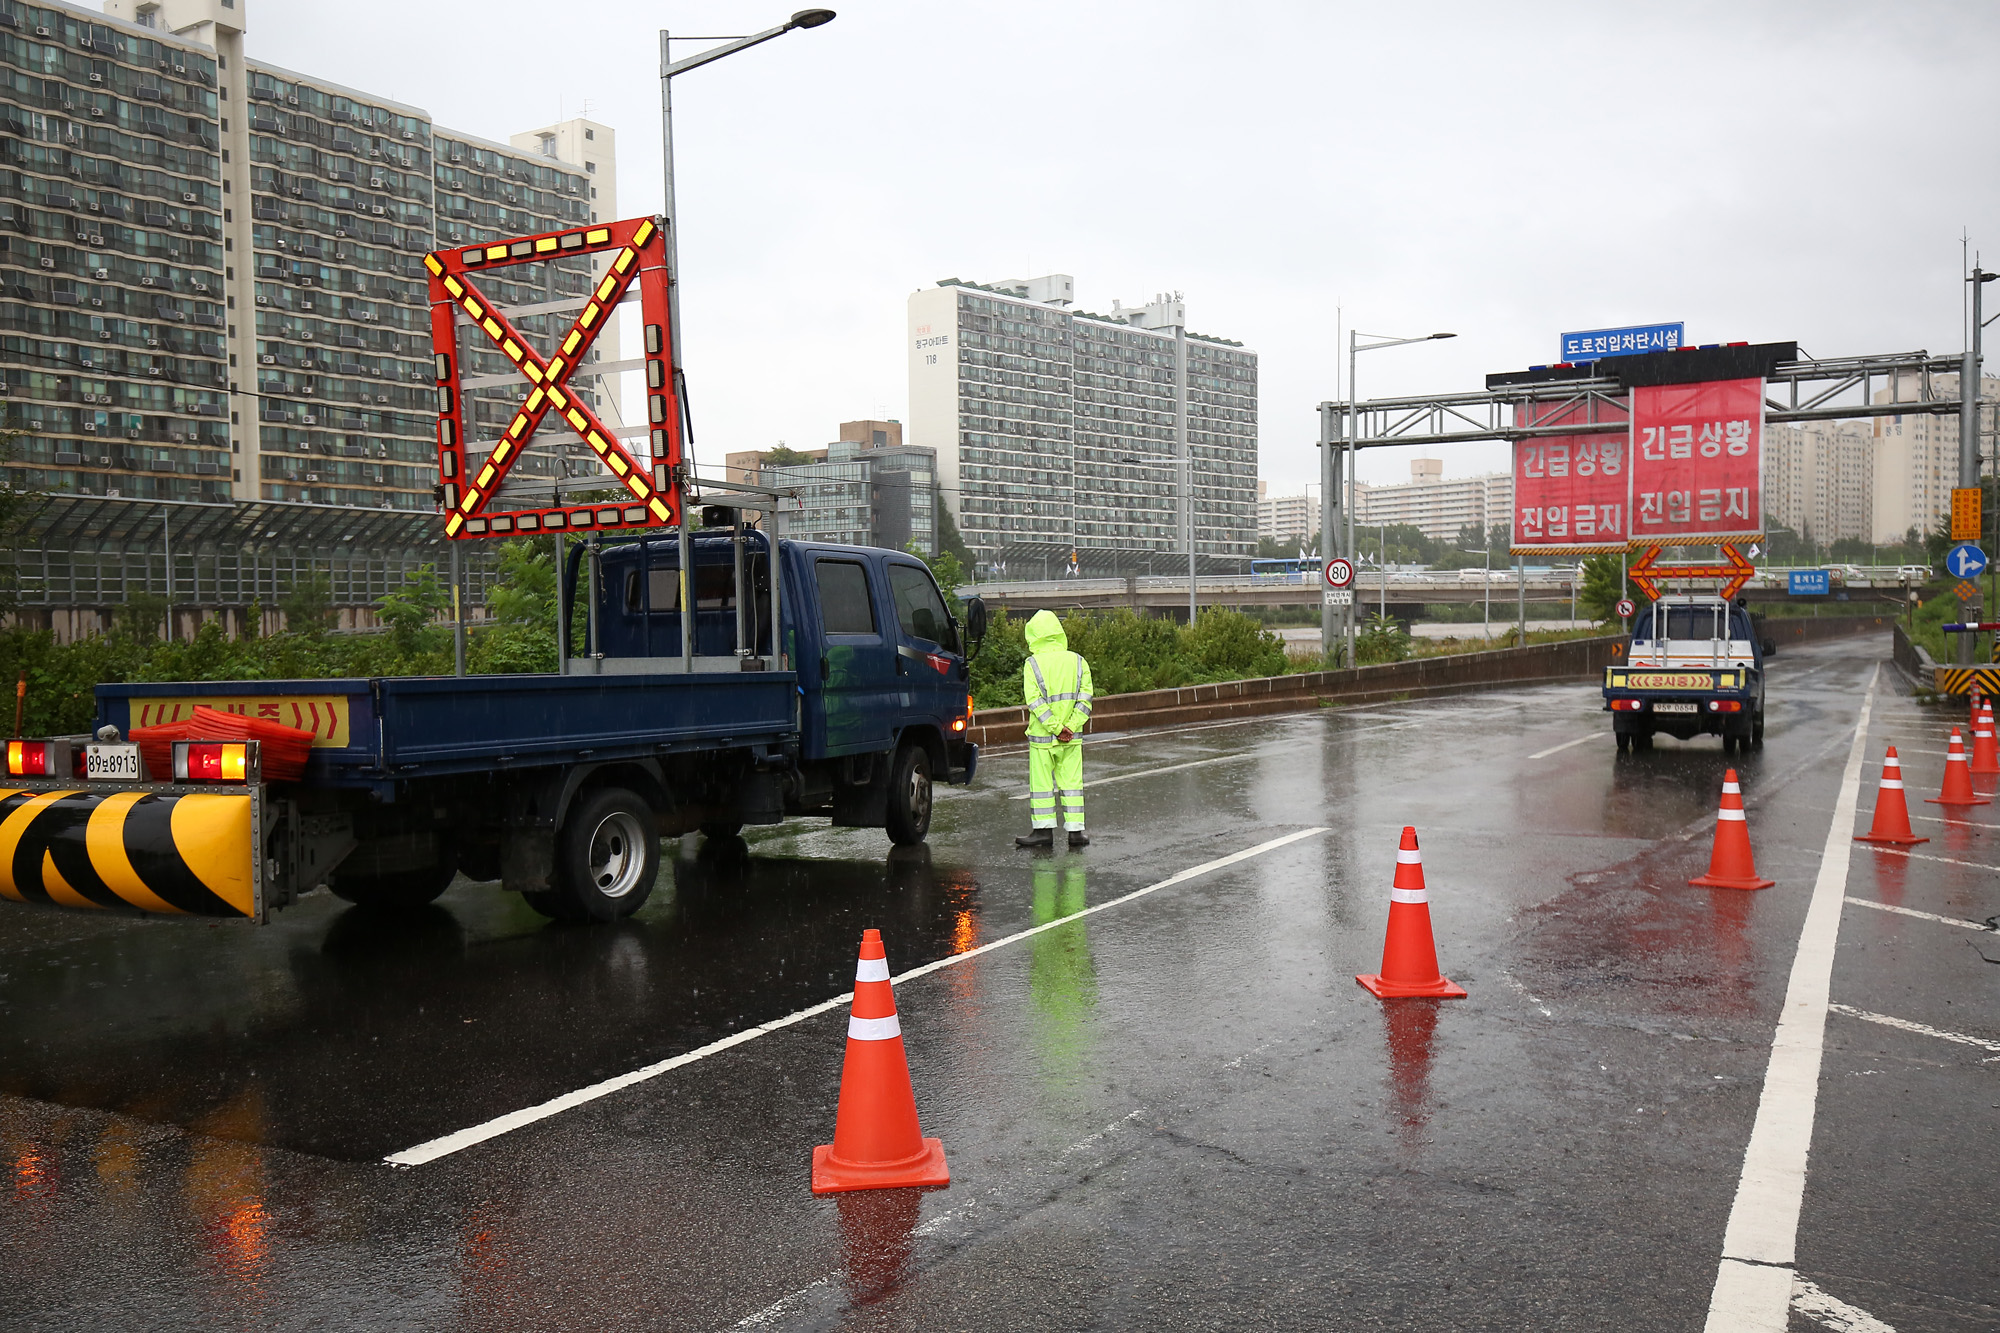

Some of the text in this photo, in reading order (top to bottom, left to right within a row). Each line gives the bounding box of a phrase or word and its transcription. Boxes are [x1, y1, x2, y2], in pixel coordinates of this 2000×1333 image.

[1566, 330, 1678, 354] 도로진입차단시설
[926, 354, 937, 365] 118
[1332, 566, 1347, 579] 80
[1652, 676, 1688, 687] 공사중
